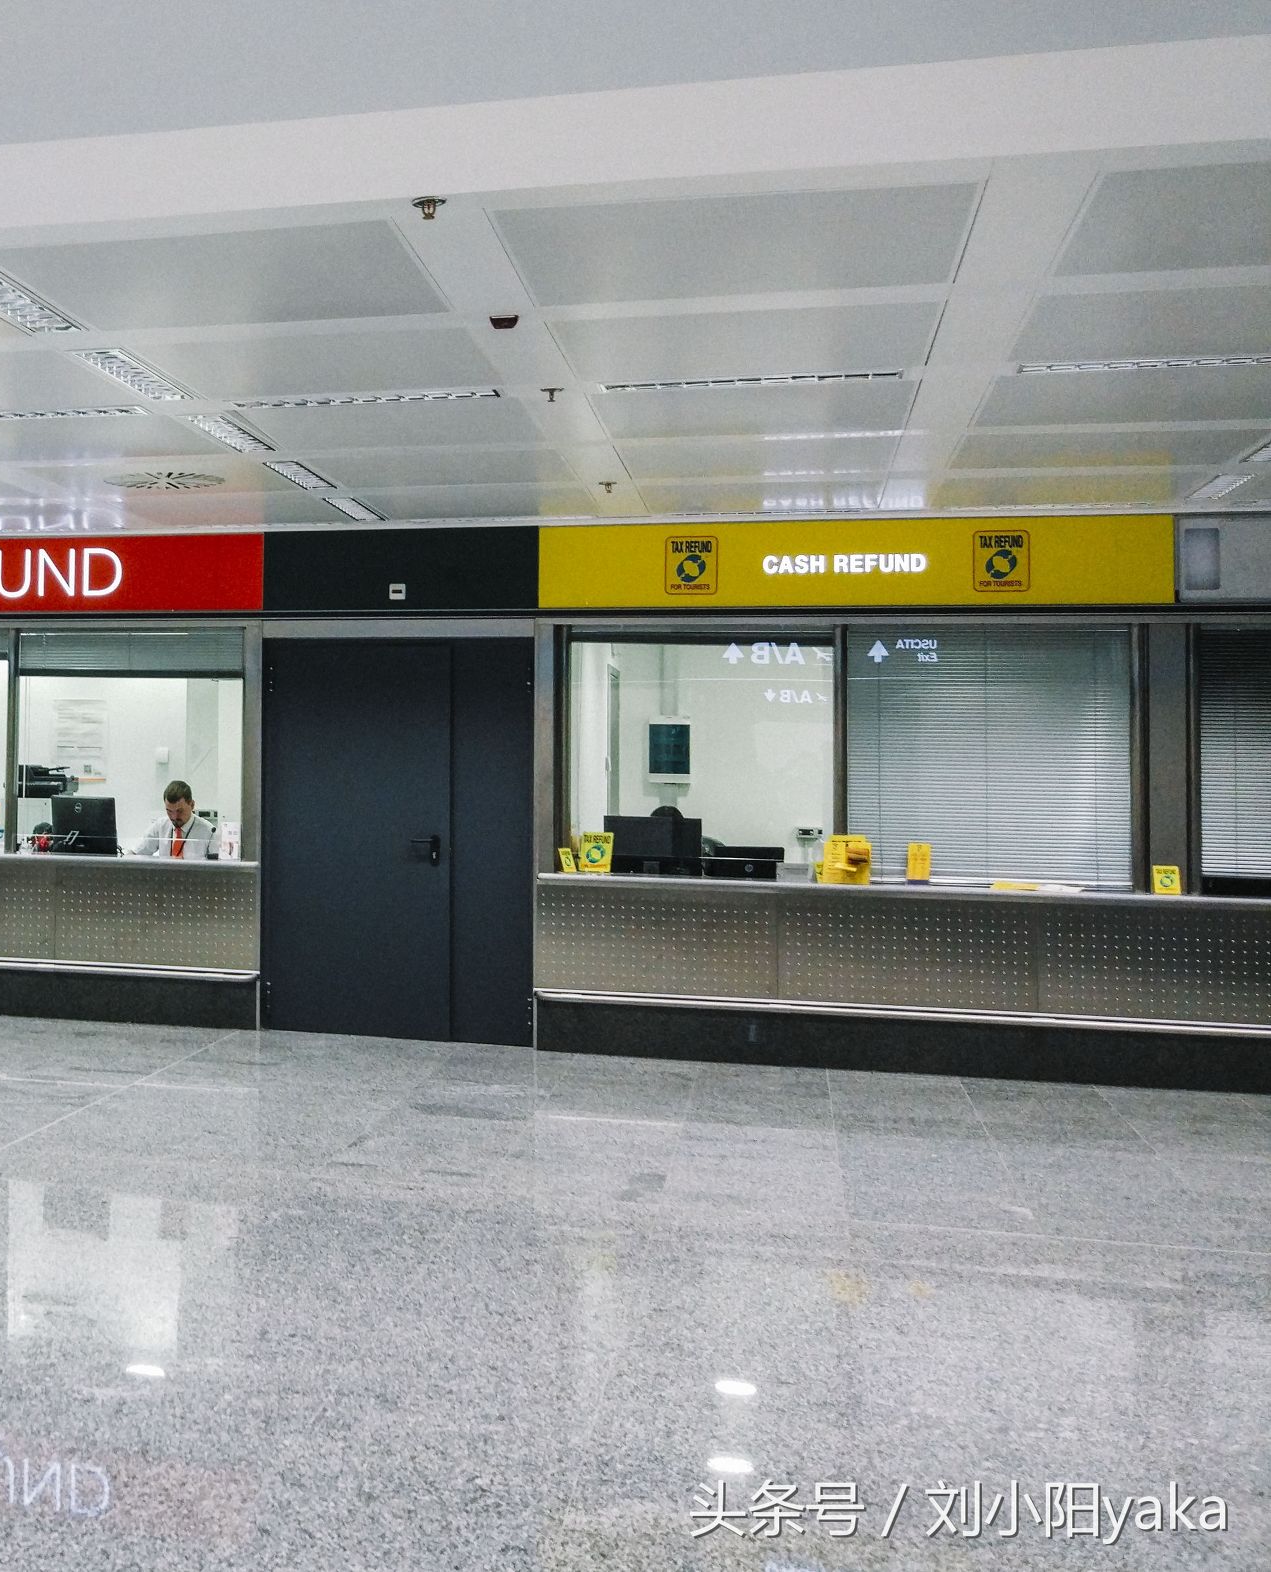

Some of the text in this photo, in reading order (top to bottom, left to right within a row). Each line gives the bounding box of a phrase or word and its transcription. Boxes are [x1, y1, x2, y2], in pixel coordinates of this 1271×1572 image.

[670, 540, 713, 553] TAX REFUND
[979, 534, 1024, 548] TAX REFUND
[762, 553, 927, 574] CASH REFUND
